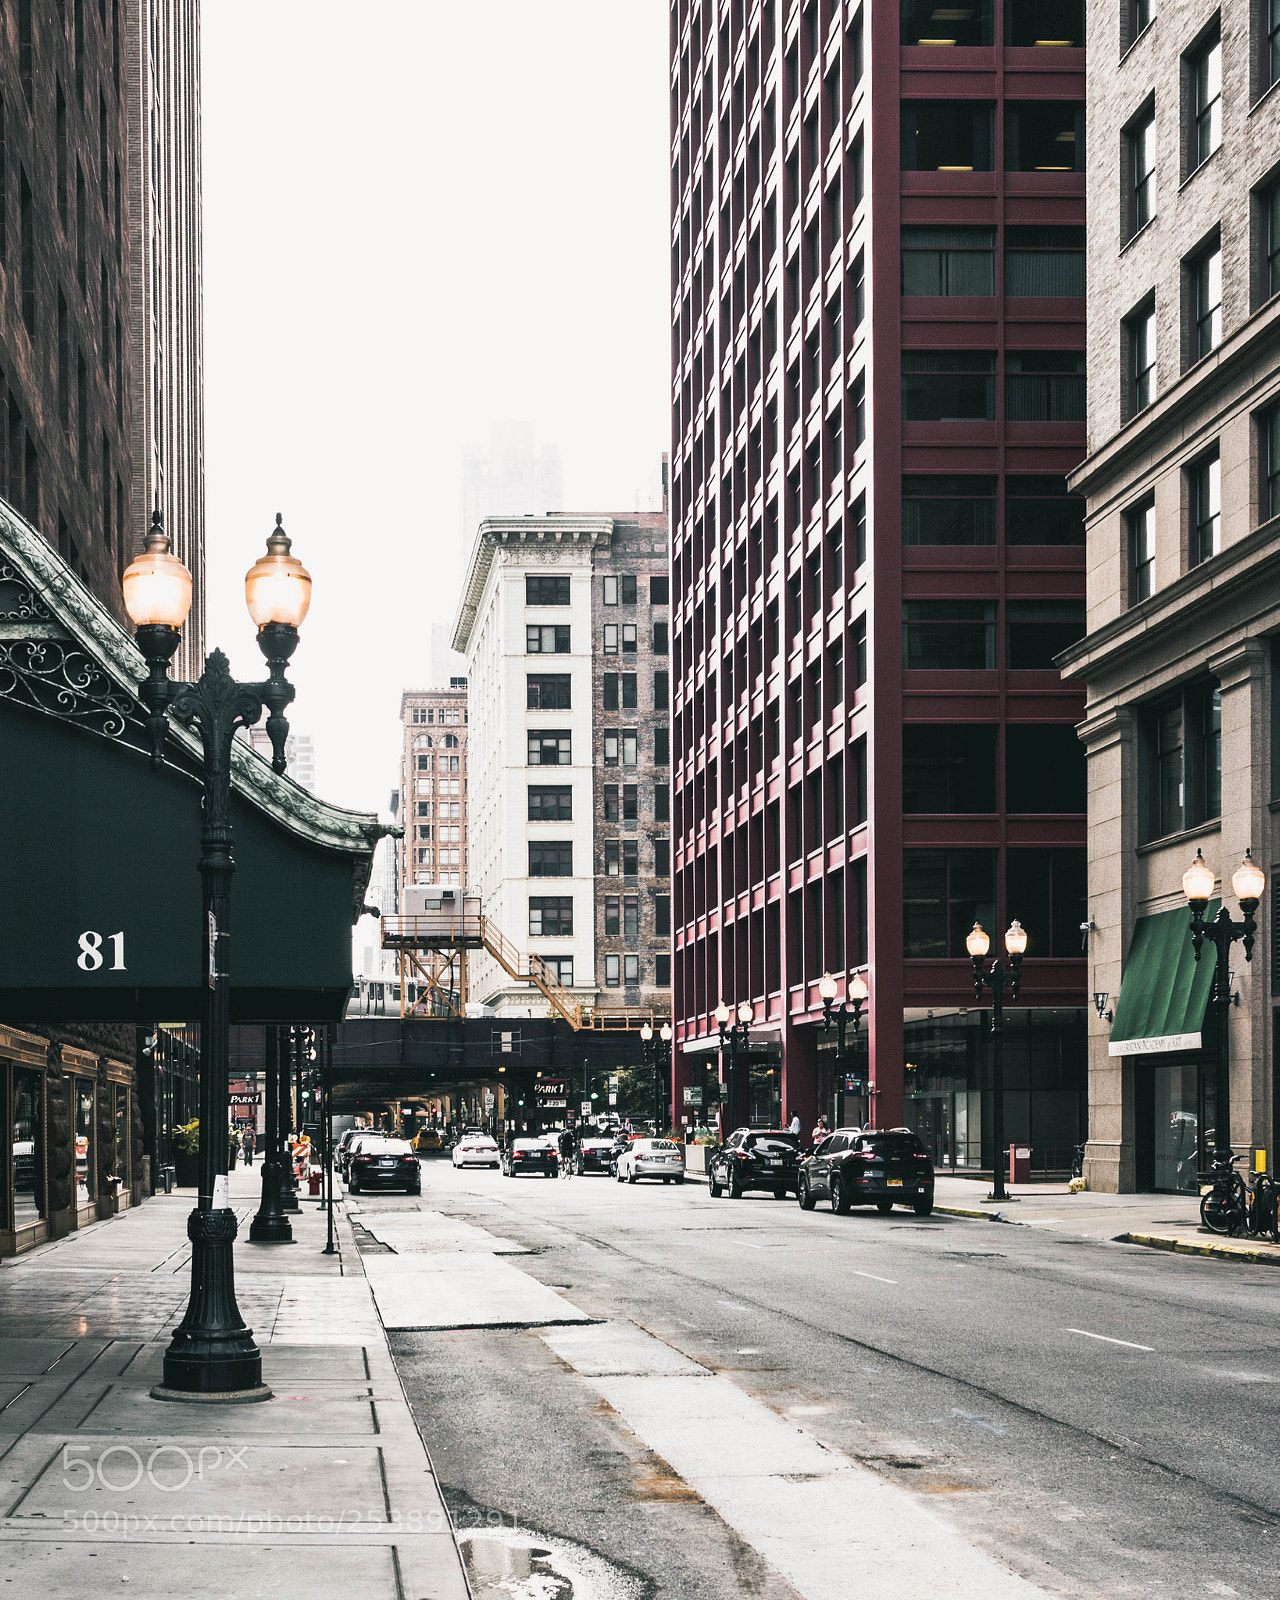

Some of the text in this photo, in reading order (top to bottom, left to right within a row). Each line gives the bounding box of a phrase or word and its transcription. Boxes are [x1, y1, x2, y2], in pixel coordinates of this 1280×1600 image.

[77, 930, 128, 971] 81
[1116, 1040, 1141, 1053] AMERICAN
[1142, 1039, 1166, 1051] ACADEMY
[1171, 1037, 1182, 1048] ART
[534, 1084, 564, 1094] PARK 1
[230, 1095, 260, 1104] PARK 1
